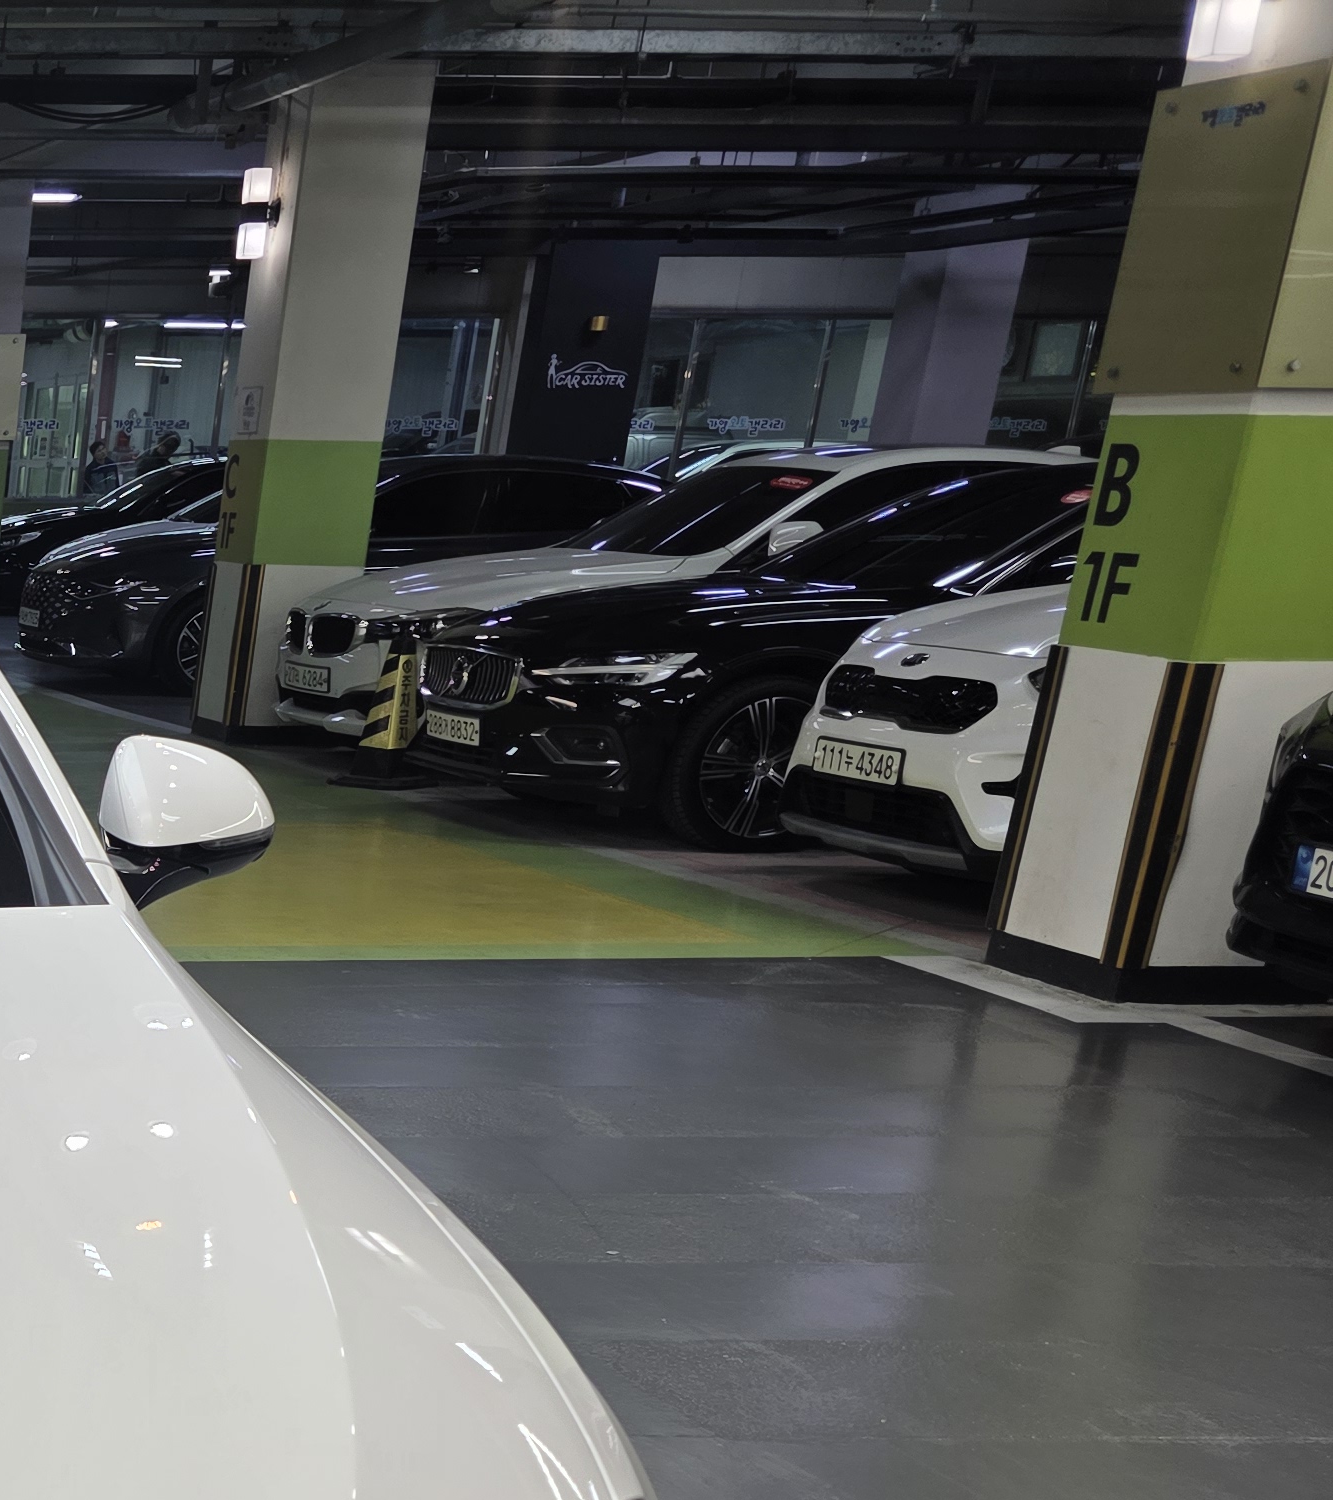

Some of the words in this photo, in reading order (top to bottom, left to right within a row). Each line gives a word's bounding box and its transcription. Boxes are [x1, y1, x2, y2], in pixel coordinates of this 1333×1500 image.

[555, 374, 580, 389] CAR
[581, 374, 626, 389] SISTER
[113, 417, 190, 437] 가양오토갤러리
[707, 417, 785, 436] 가양오토갤러리
[225, 454, 240, 499] C
[1093, 443, 1140, 527] B
[220, 512, 237, 549] 1F
[1080, 551, 1140, 624] 1F
[398, 675, 412, 741] 주차금지
[450, 719, 475, 742] 8832
[821, 744, 853, 772] 111누
[855, 750, 895, 780] 4348
